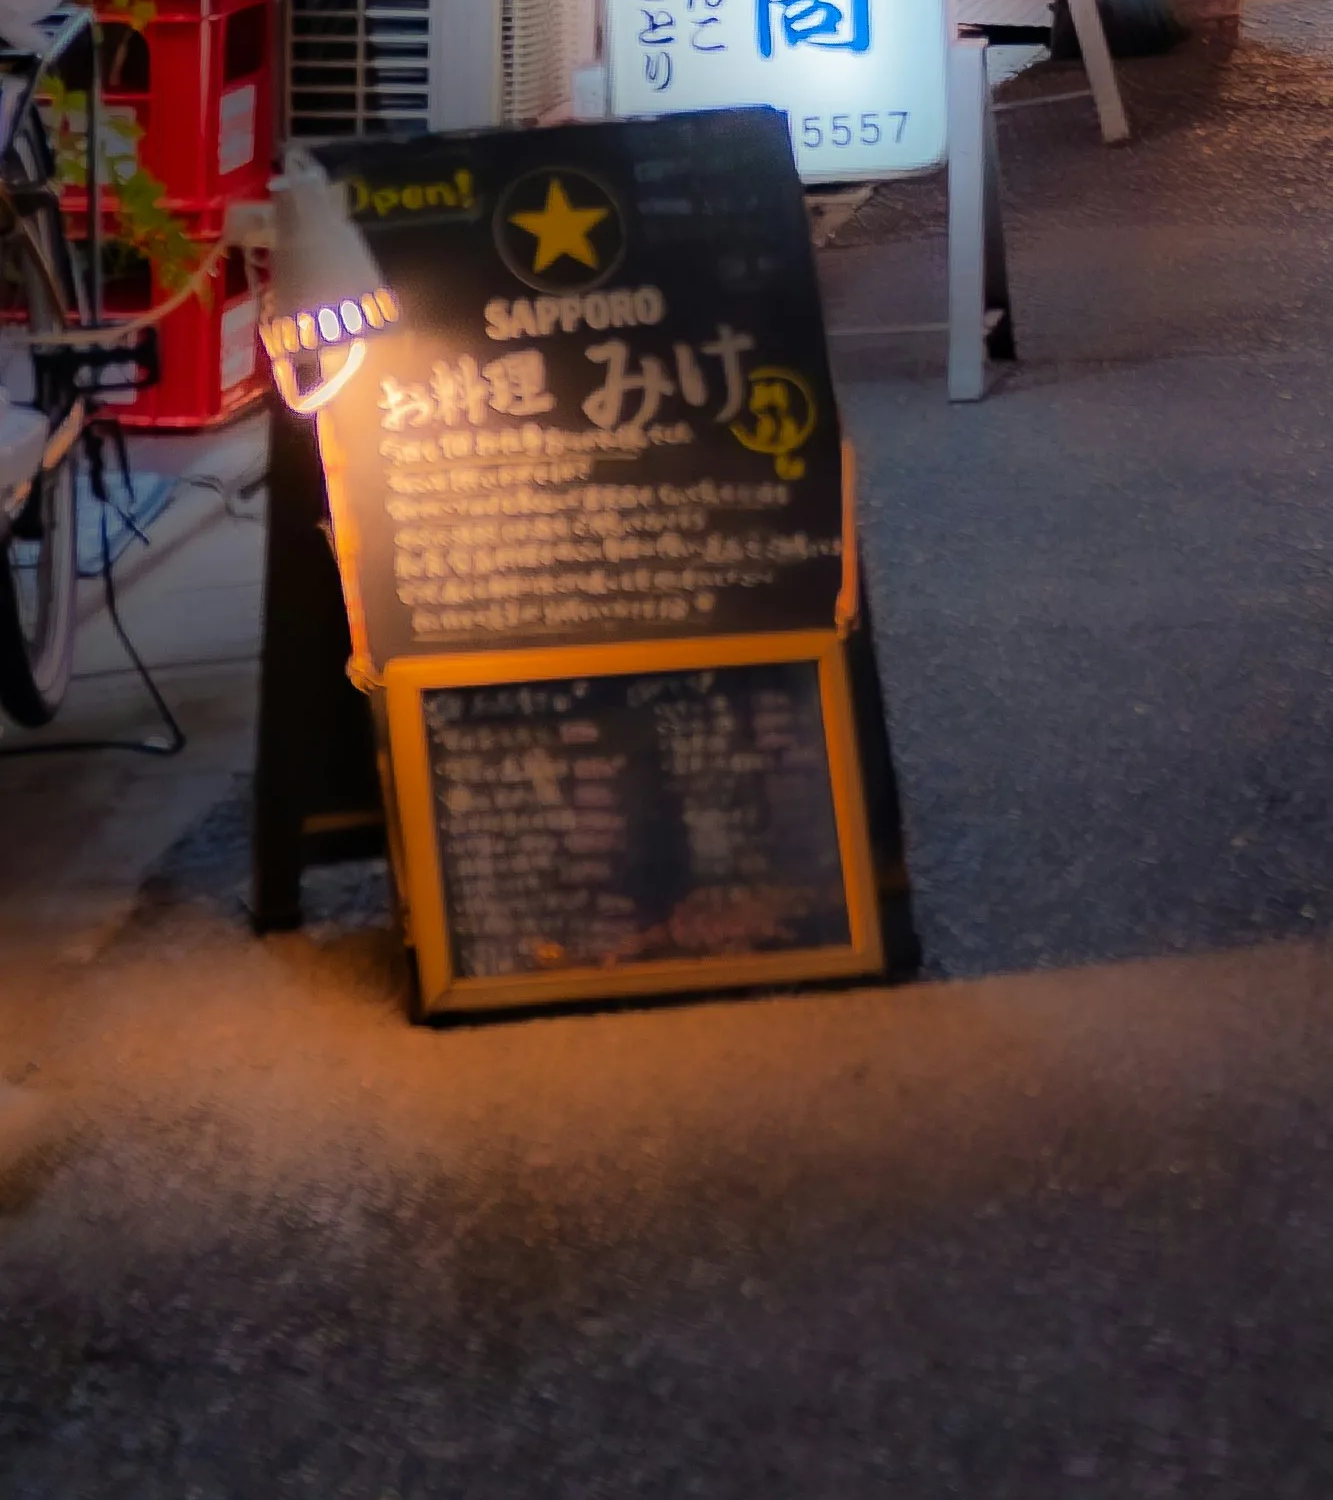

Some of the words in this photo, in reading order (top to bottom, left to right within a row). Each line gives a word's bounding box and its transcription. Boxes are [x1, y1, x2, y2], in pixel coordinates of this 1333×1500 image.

[801, 110, 912, 150] 5557
[484, 286, 667, 342] SAPPORO
[376, 350, 556, 434] お料理
[583, 322, 756, 434] みけ
